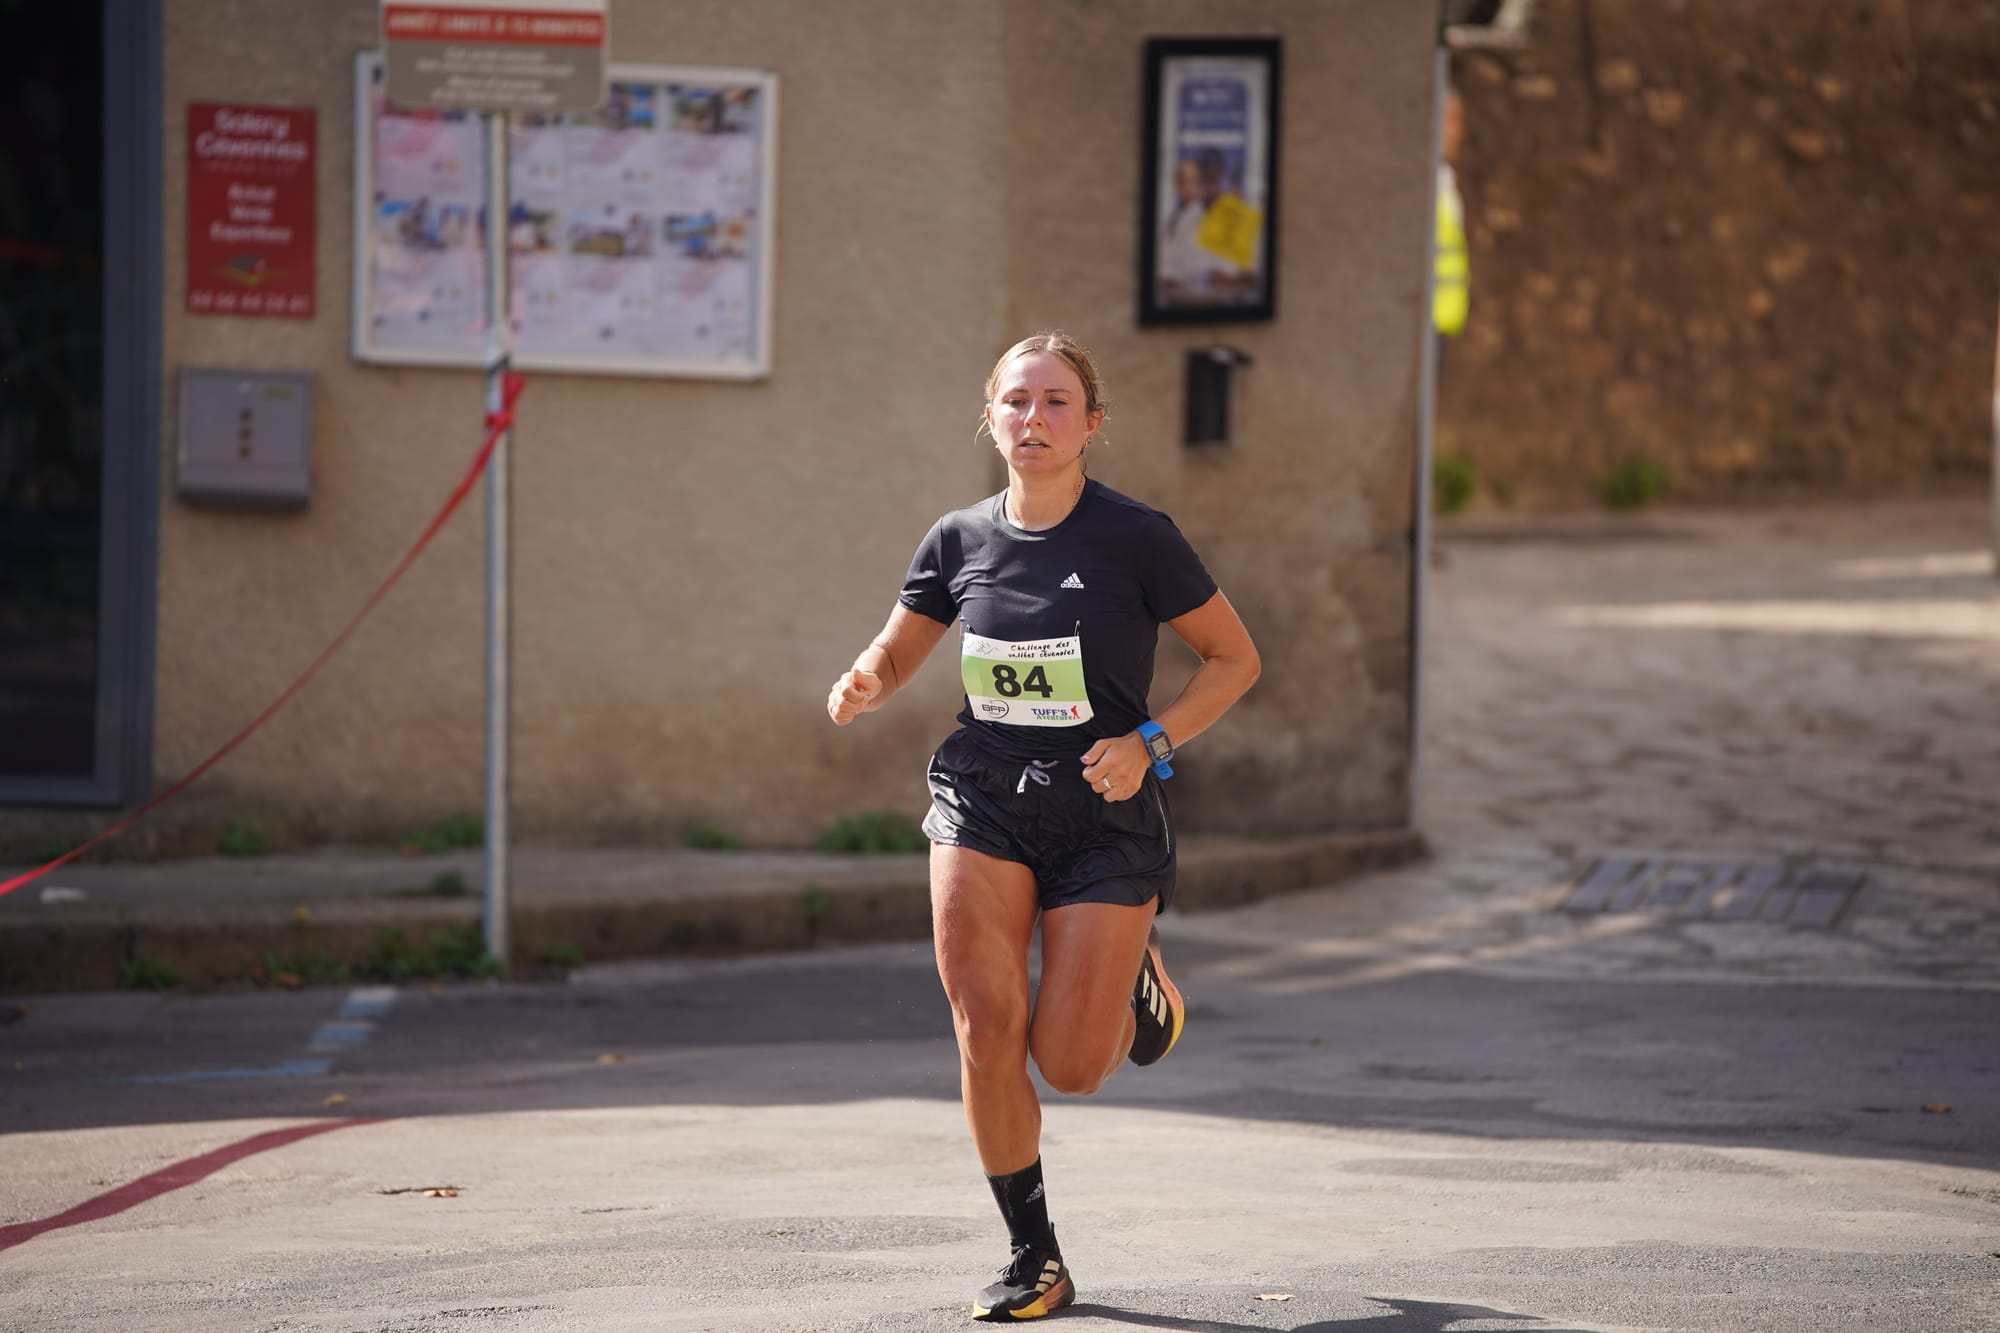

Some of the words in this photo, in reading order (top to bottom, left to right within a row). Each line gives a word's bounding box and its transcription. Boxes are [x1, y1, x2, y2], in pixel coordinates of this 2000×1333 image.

[1010, 644, 1050, 652] Challenge
[992, 664, 1053, 698] 84
[1031, 708, 1068, 716] TUFF'S
